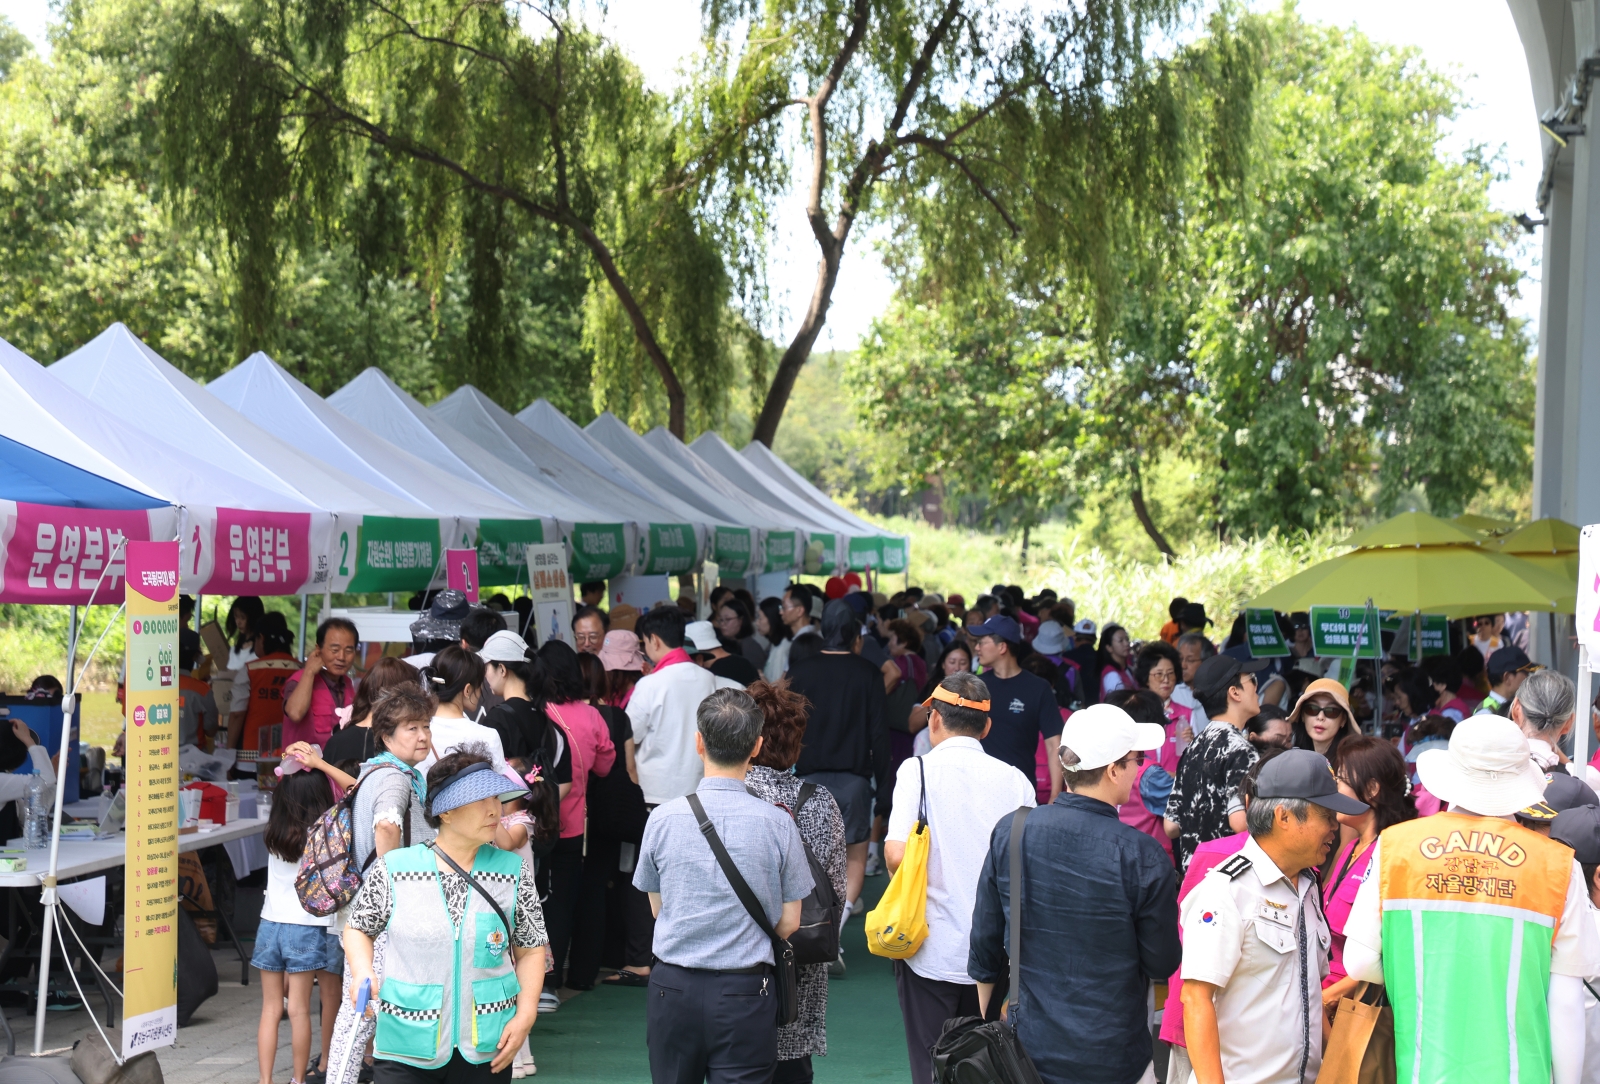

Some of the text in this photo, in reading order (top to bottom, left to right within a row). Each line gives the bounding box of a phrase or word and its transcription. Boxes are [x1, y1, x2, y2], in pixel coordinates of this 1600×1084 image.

[28, 523, 125, 590] 운영본부
[229, 524, 292, 582] 운영본부
[339, 531, 348, 576] 2
[1339, 608, 1350, 619] 10
[1320, 623, 1346, 633] 무더위
[1324, 634, 1350, 645] 얼음물
[258, 687, 281, 700] 의용
[1420, 830, 1527, 867] CAIND
[1444, 857, 1499, 875] 강남구
[136, 885, 140, 893] 11
[1427, 873, 1516, 898] 자율방재단
[135, 915, 140, 923] 13
